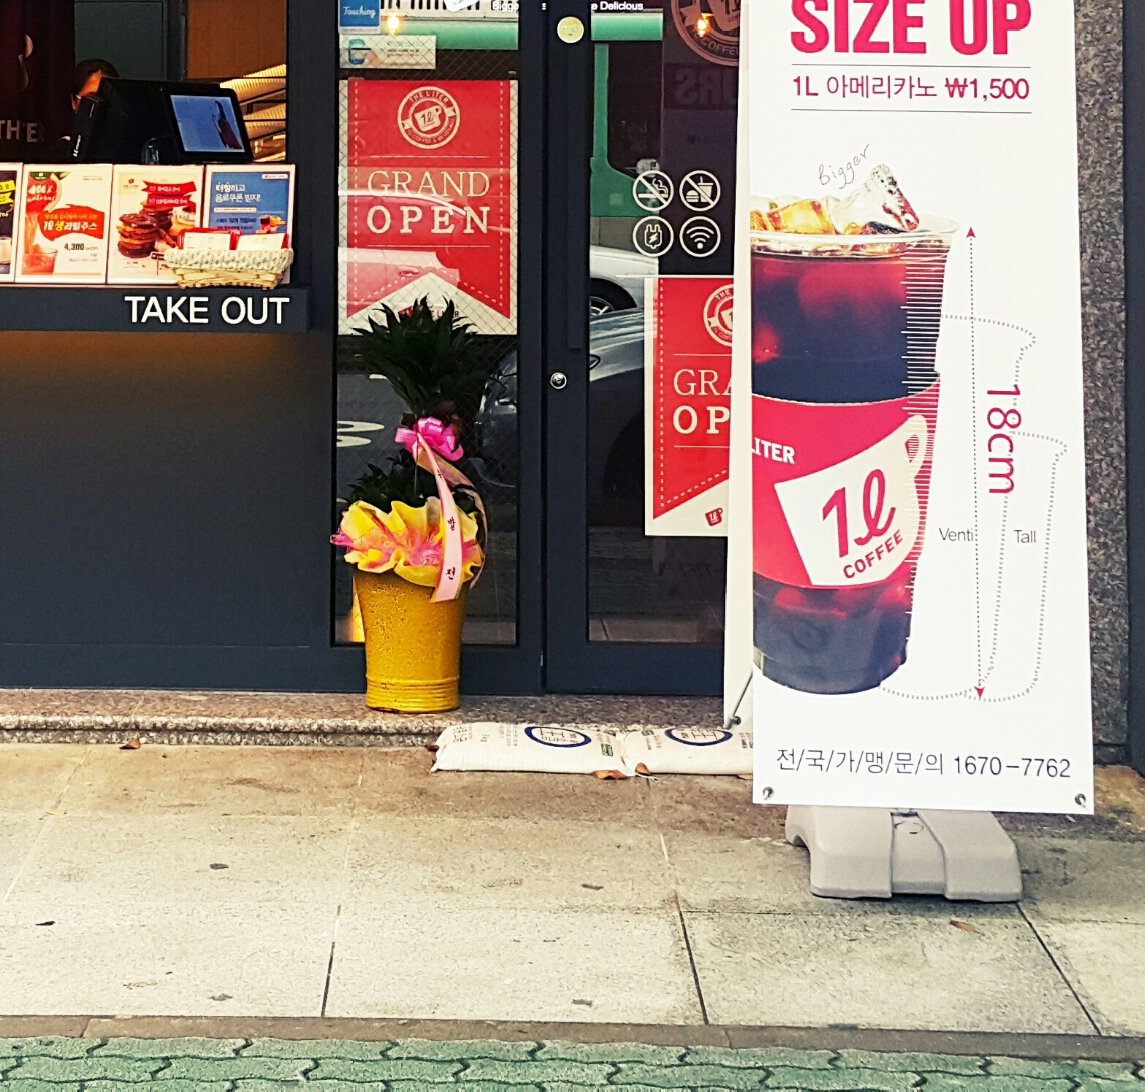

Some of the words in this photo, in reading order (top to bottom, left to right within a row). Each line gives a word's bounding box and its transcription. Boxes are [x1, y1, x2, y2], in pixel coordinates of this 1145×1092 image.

[600, 1, 643, 10] Delicious
[409, 92, 423, 102] THE
[426, 91, 448, 103] LITER
[793, 75, 819, 96] 1L
[827, 75, 938, 99] 아메리카노
[367, 170, 490, 197] GRAND
[367, 205, 490, 234] OPEN
[125, 296, 209, 323] TAKE
[221, 296, 290, 324] OUT
[986, 384, 1021, 494] 18cm
[938, 527, 973, 542] Venti
[1013, 529, 1036, 543] Tall
[843, 529, 903, 579] COFFEE
[955, 756, 1071, 778] 1670-7762
